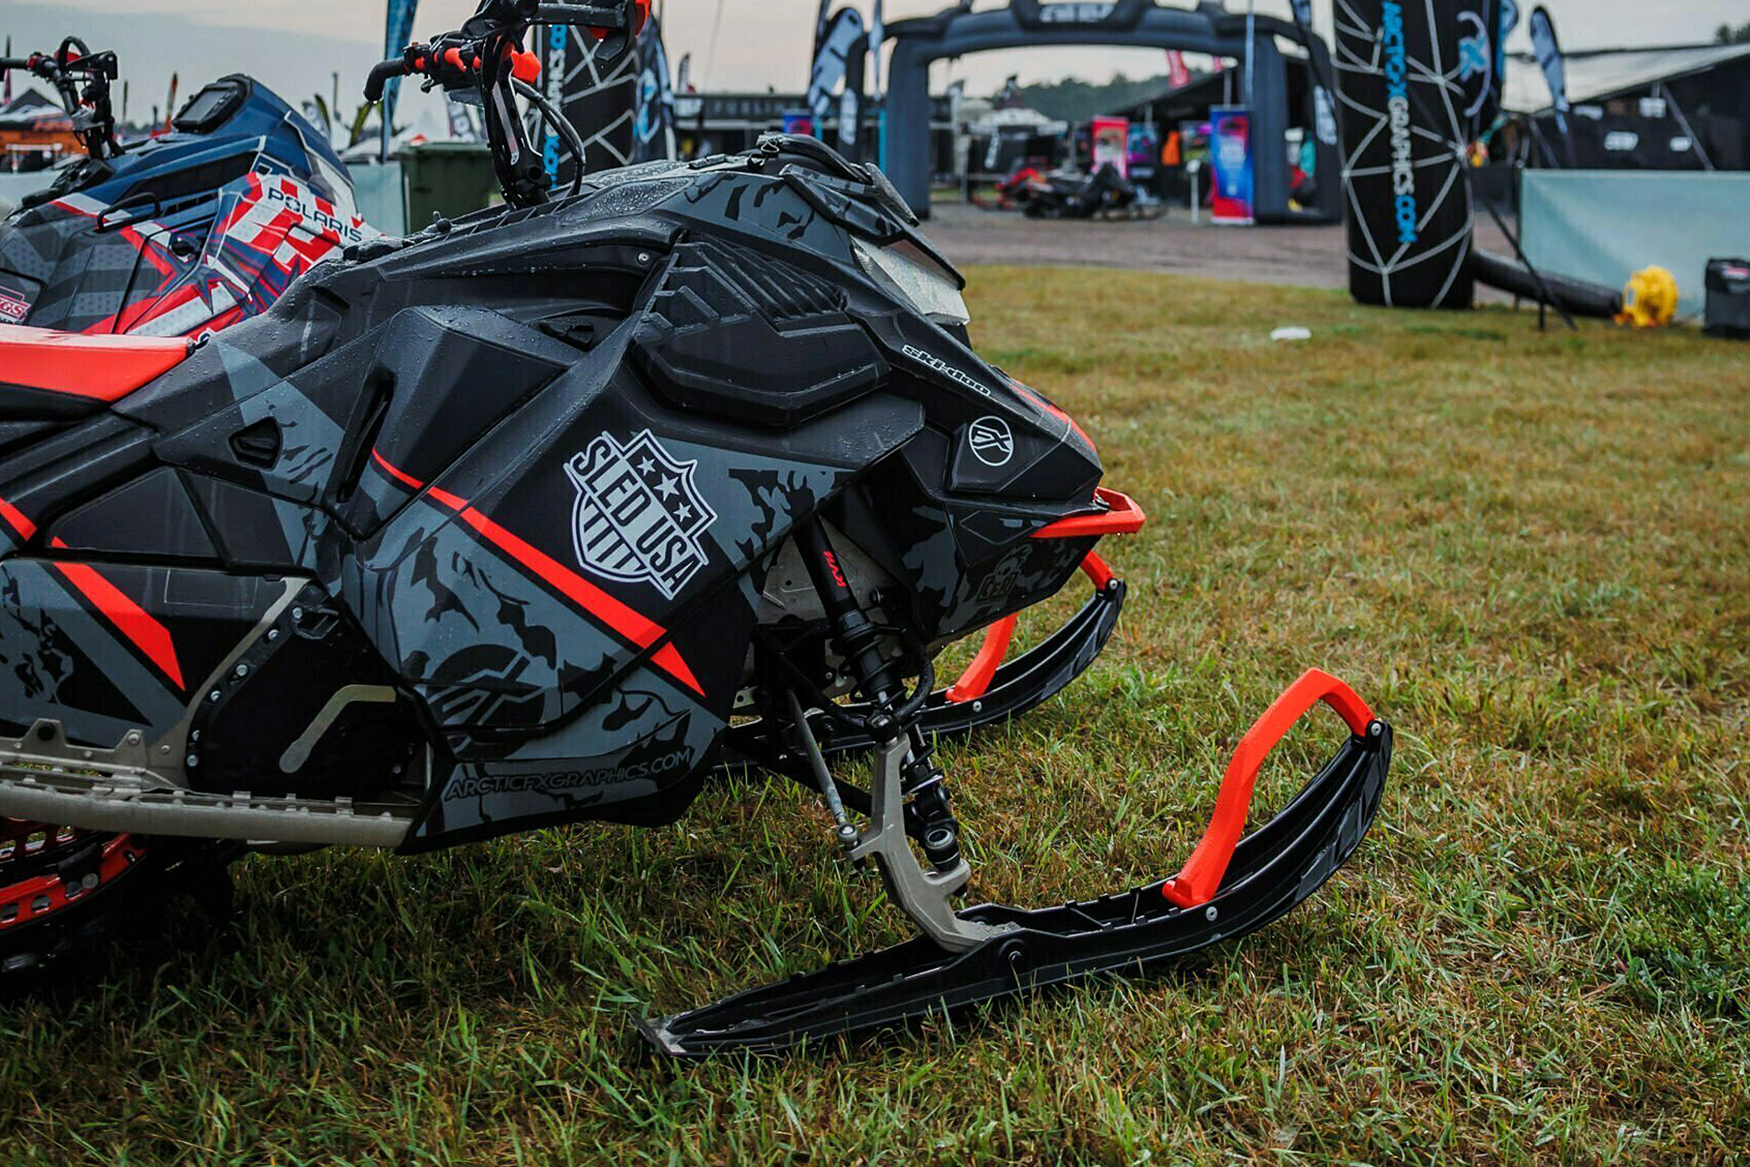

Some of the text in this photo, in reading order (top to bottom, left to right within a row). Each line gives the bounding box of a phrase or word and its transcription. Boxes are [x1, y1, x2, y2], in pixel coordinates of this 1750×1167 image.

[268, 187, 362, 243] POLARIS
[572, 438, 702, 593] SLED USA
[444, 750, 691, 801] ARCTICFXGRAPHICS.COM
